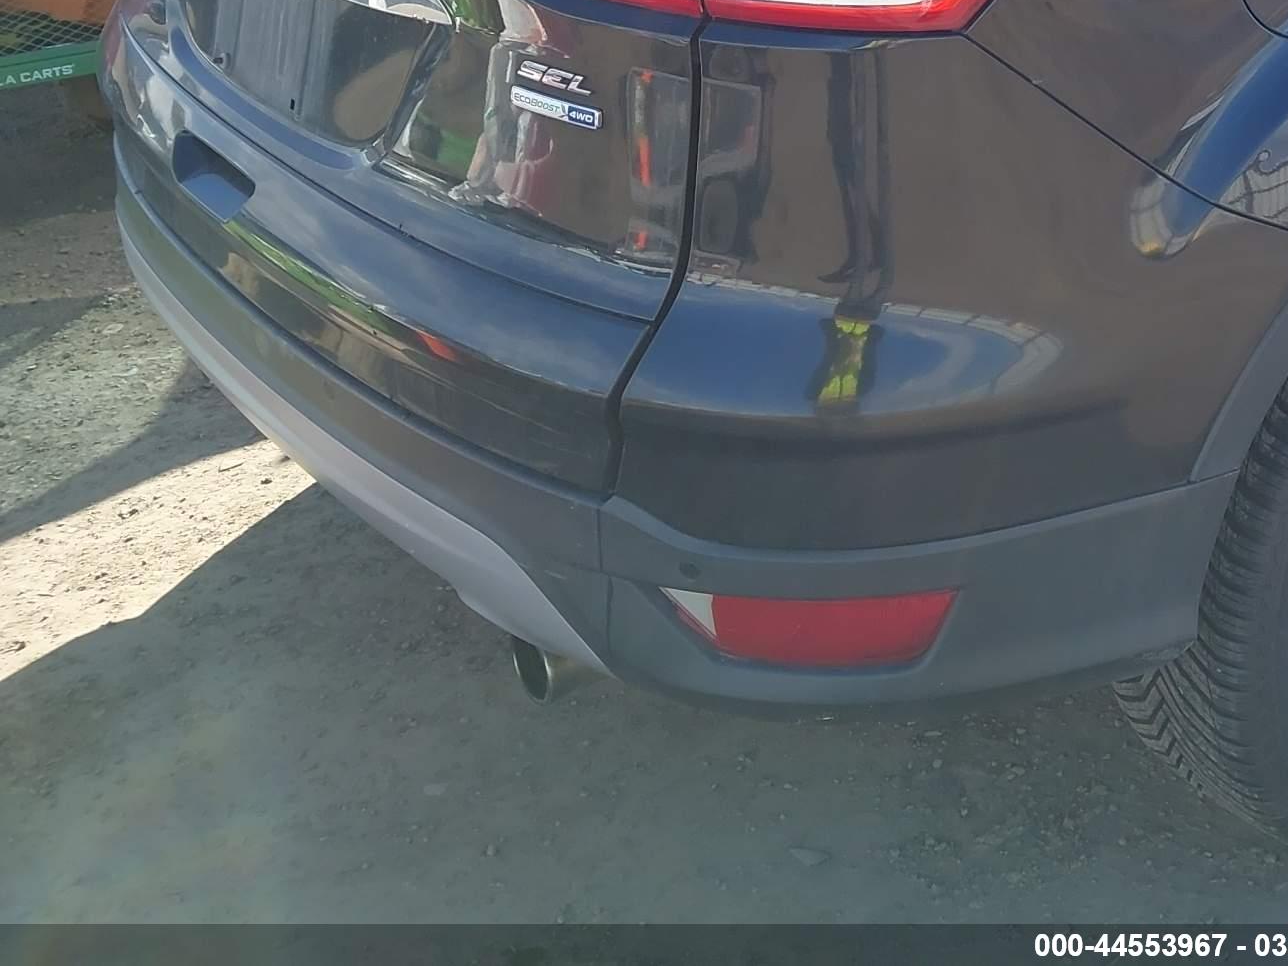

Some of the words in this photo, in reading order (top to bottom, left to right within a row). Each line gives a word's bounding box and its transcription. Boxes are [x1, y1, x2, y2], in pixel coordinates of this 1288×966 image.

[0, 75, 17, 86] A
[20, 64, 73, 83] CARTS
[517, 60, 592, 96] SEL
[569, 110, 594, 124] 4WD
